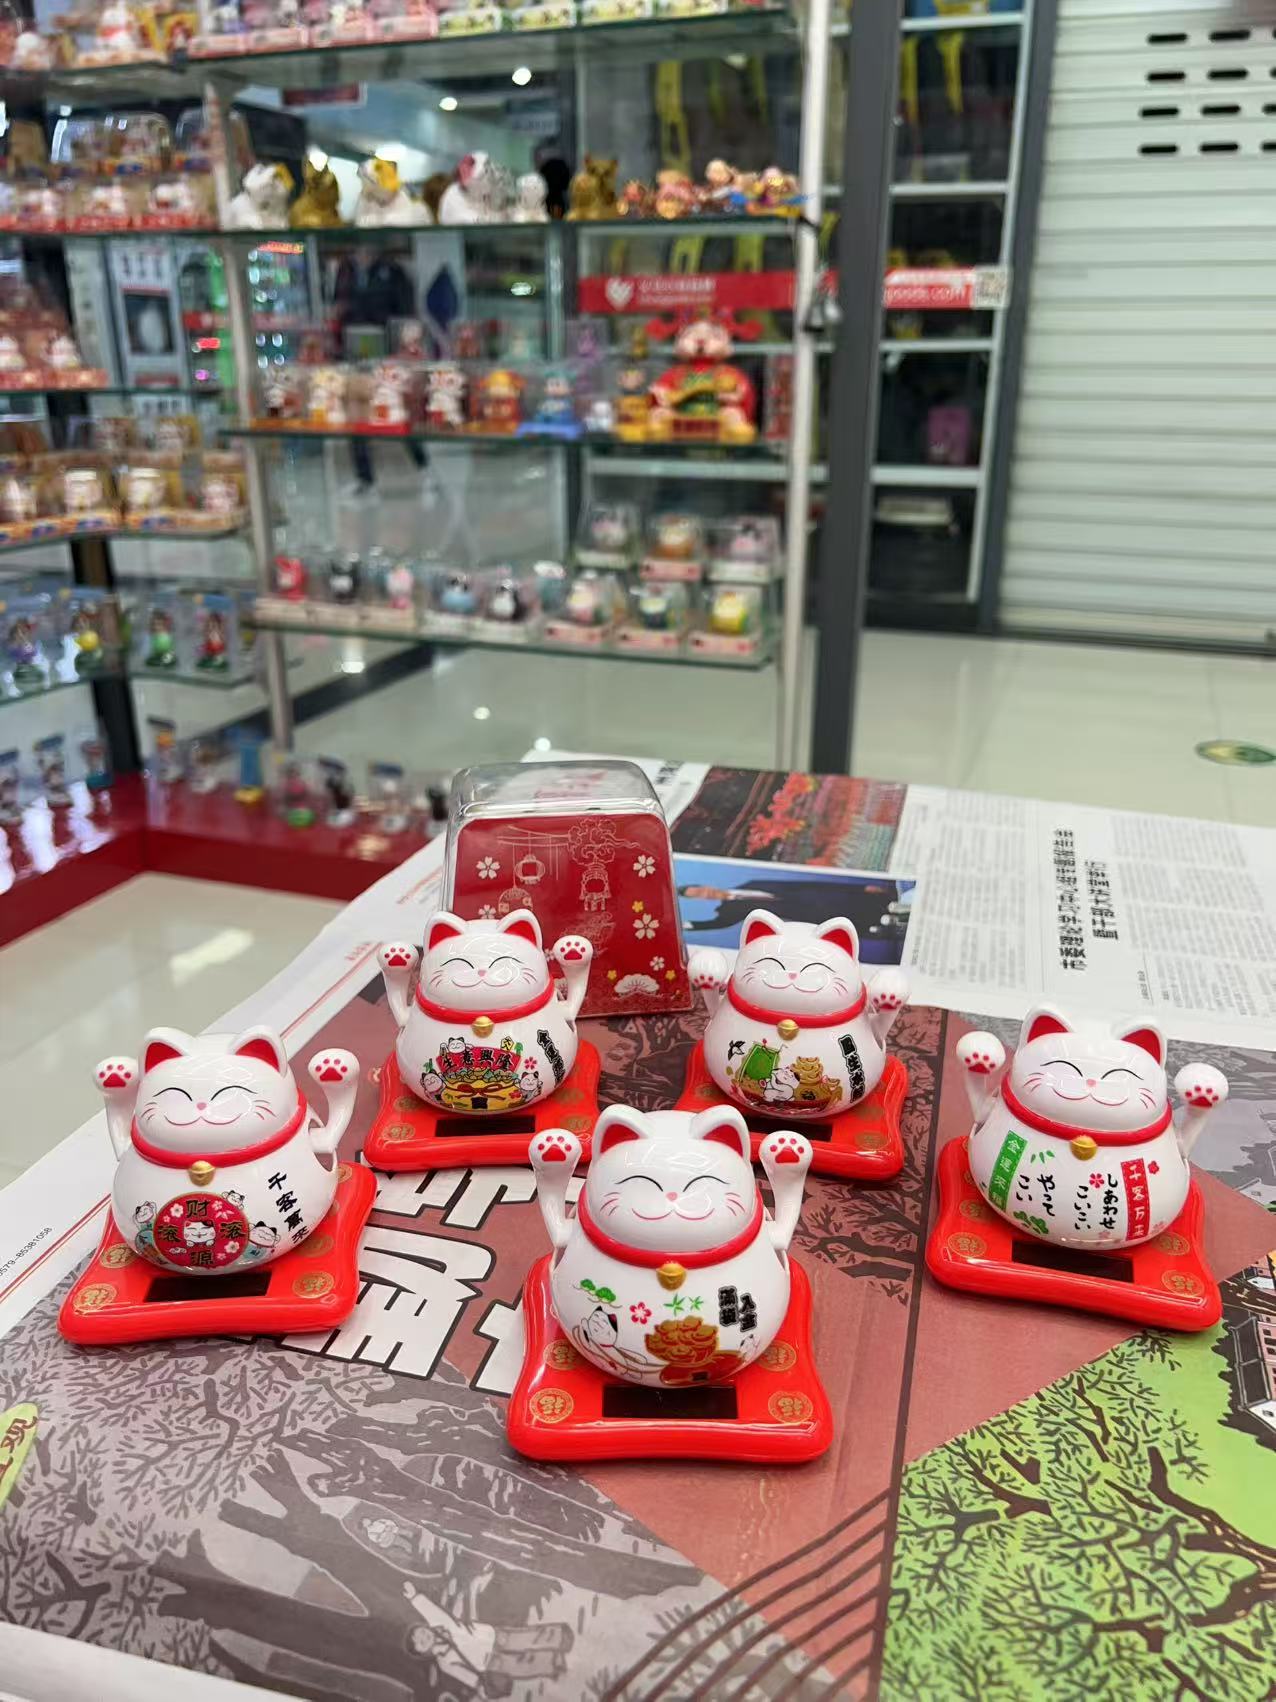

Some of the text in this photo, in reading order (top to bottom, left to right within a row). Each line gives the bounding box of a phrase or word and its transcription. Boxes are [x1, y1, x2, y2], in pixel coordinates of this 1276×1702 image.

[1016, 1174, 1033, 1202] こい
[1037, 1173, 1056, 1217] やって
[1074, 1185, 1092, 1230] こいこい
[1099, 1173, 1119, 1230] しあわせ
